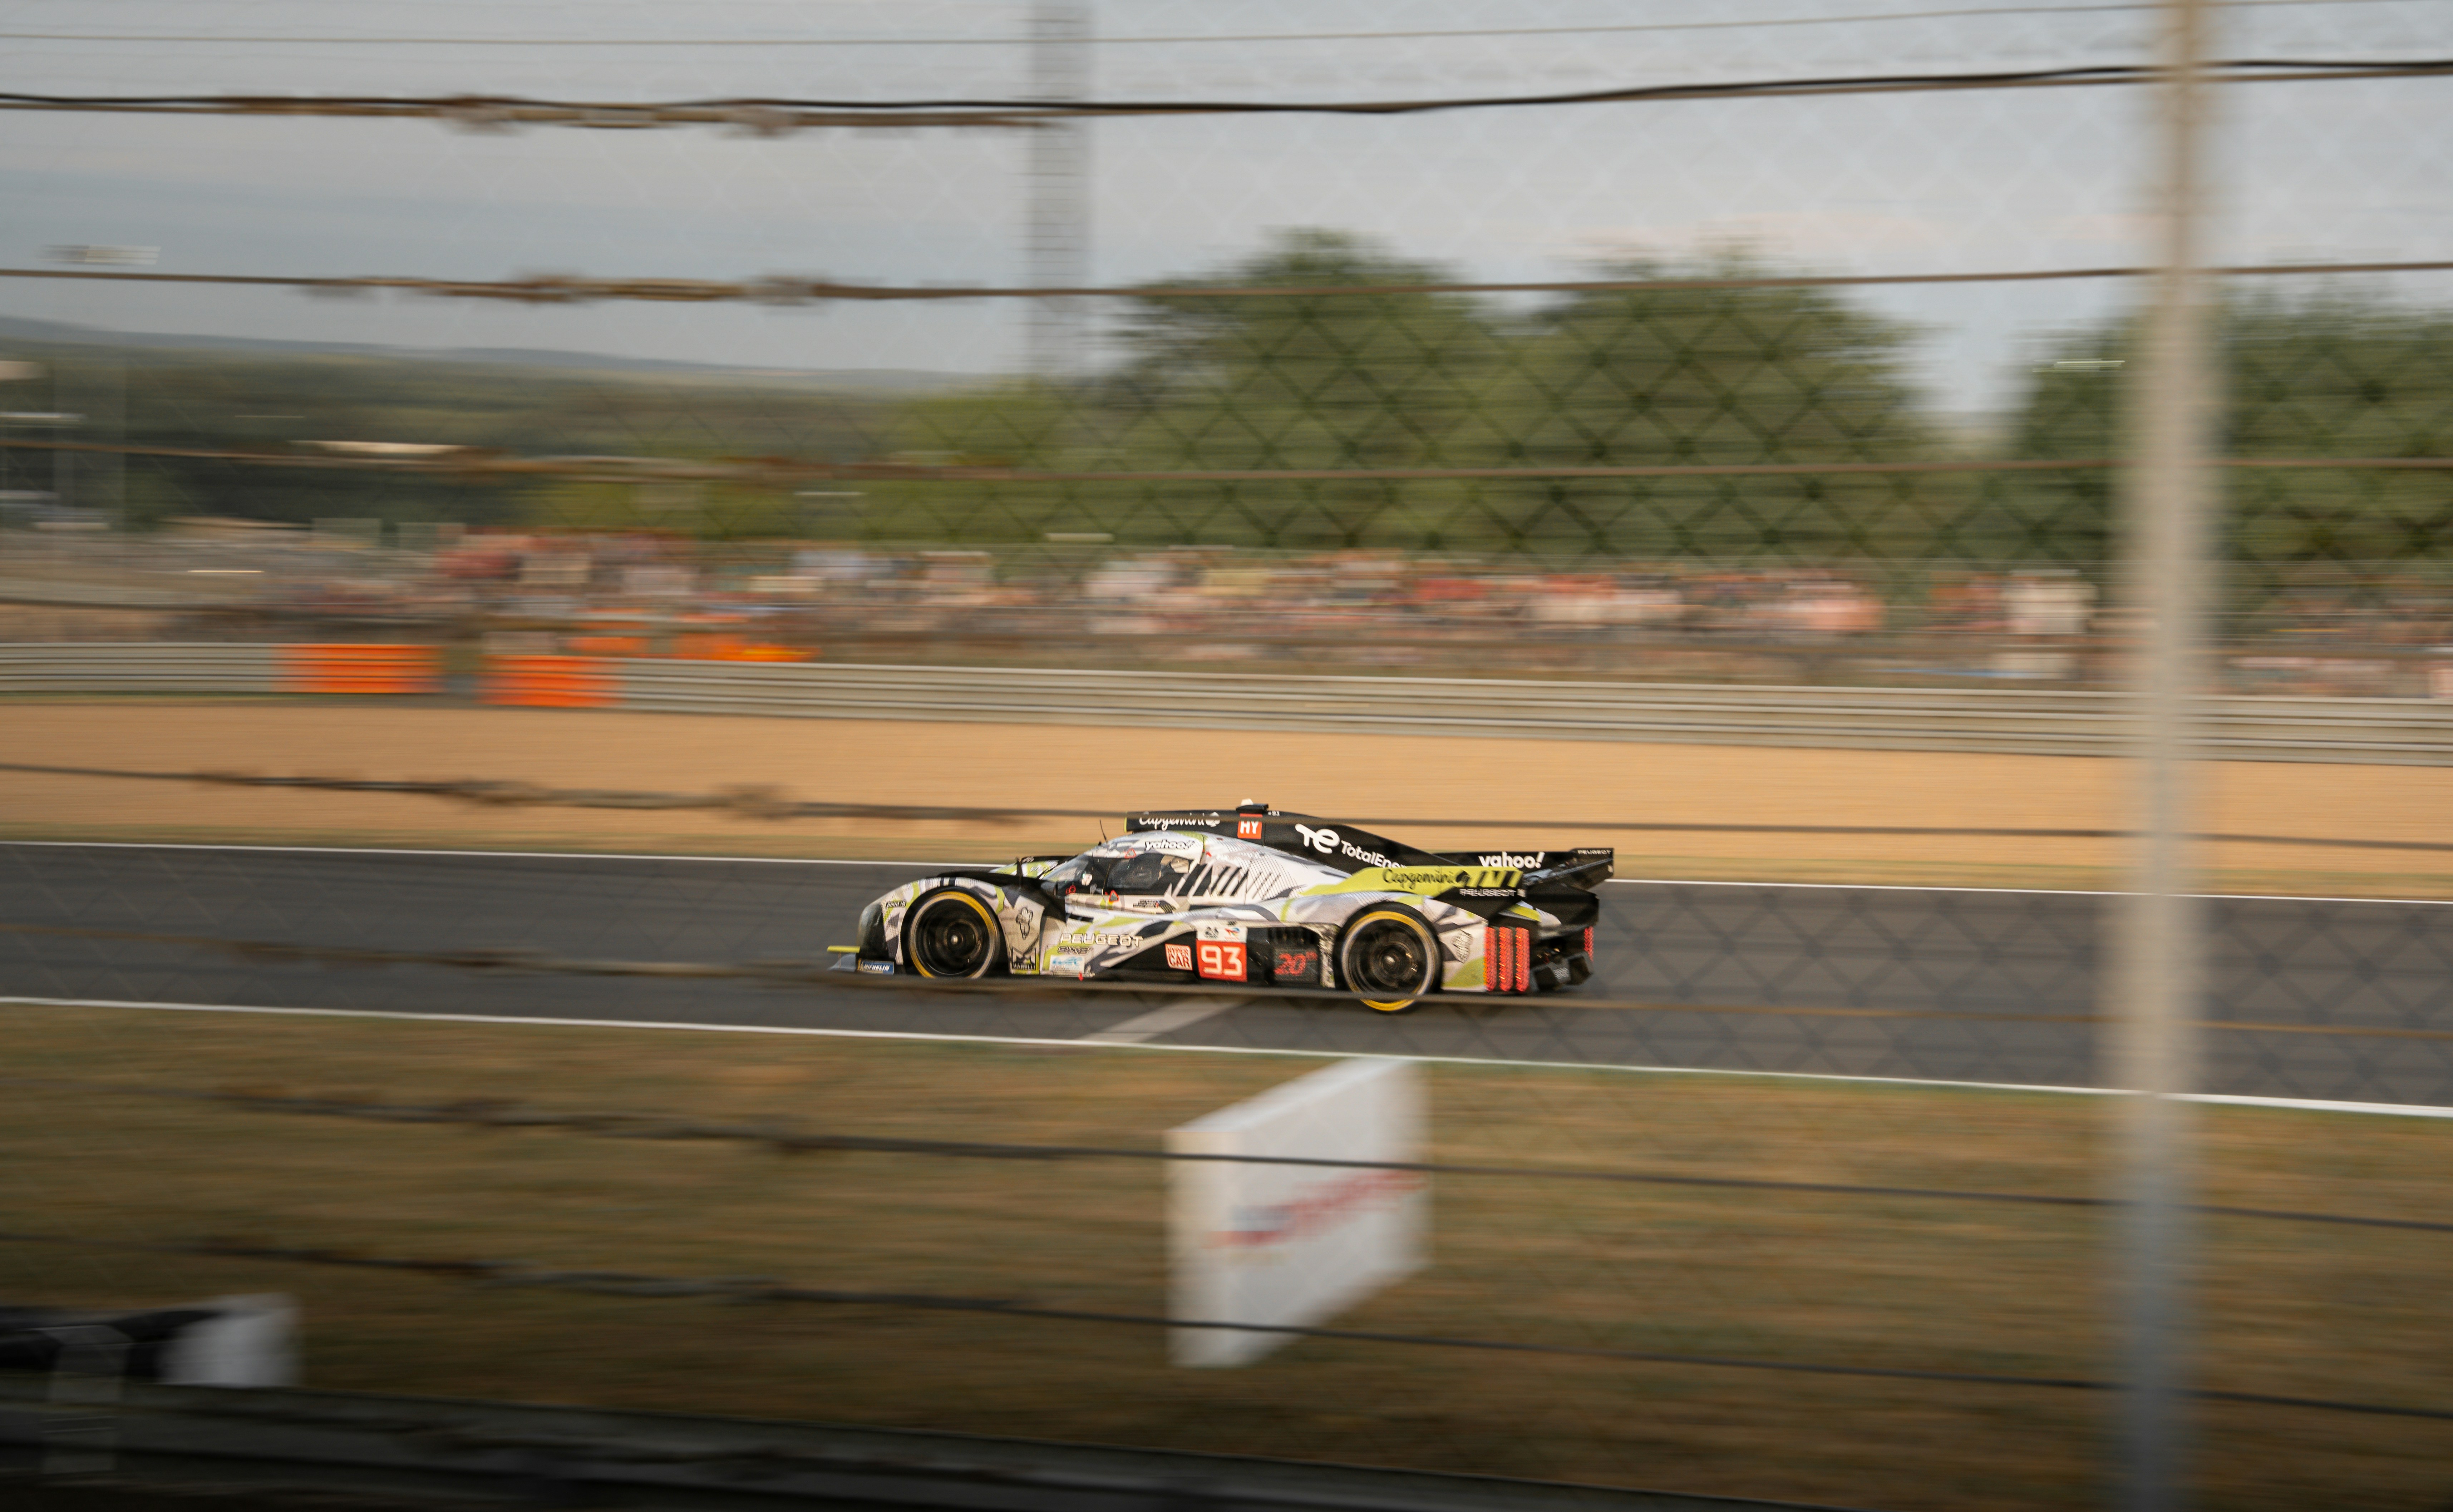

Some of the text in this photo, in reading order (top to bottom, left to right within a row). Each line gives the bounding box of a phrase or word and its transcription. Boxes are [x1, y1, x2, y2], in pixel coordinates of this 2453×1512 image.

[1240, 821, 1258, 834] HY
[1144, 840, 1194, 851] yahoo!
[1382, 869, 1455, 890] Capgemini
[1060, 933, 1143, 947] PEUGEOT
[1168, 955, 1190, 968] CAR
[1201, 944, 1242, 977] 93
[863, 963, 890, 972] MICHELIN
